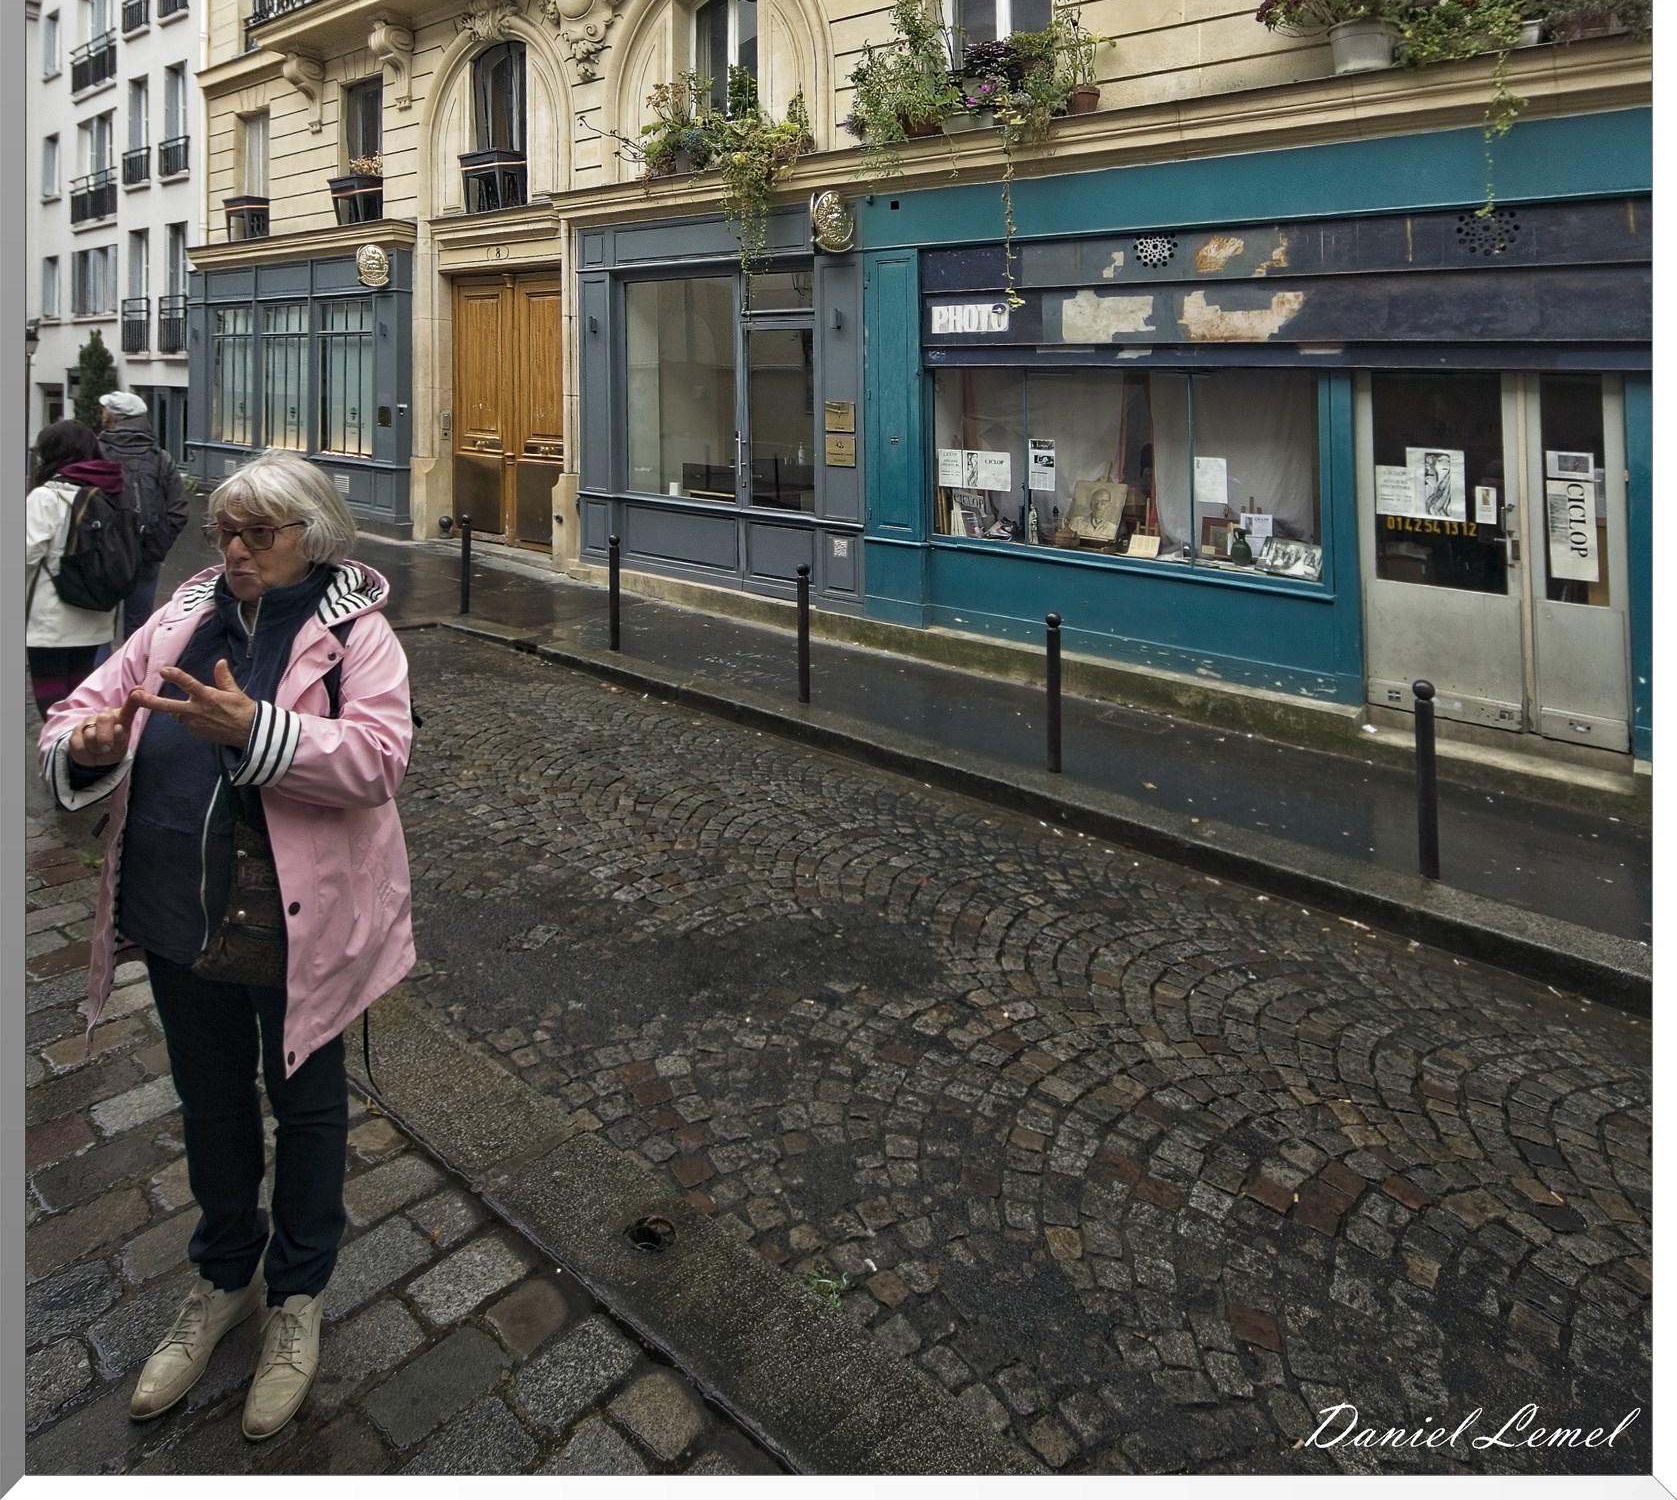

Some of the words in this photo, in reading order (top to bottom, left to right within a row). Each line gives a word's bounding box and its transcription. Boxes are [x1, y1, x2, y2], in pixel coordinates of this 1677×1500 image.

[495, 247, 501, 259] 8
[932, 304, 1009, 333] PHOTO
[1445, 521, 1459, 535] 13
[1462, 522, 1477, 537] 12
[1567, 483, 1589, 558] CICLOP
